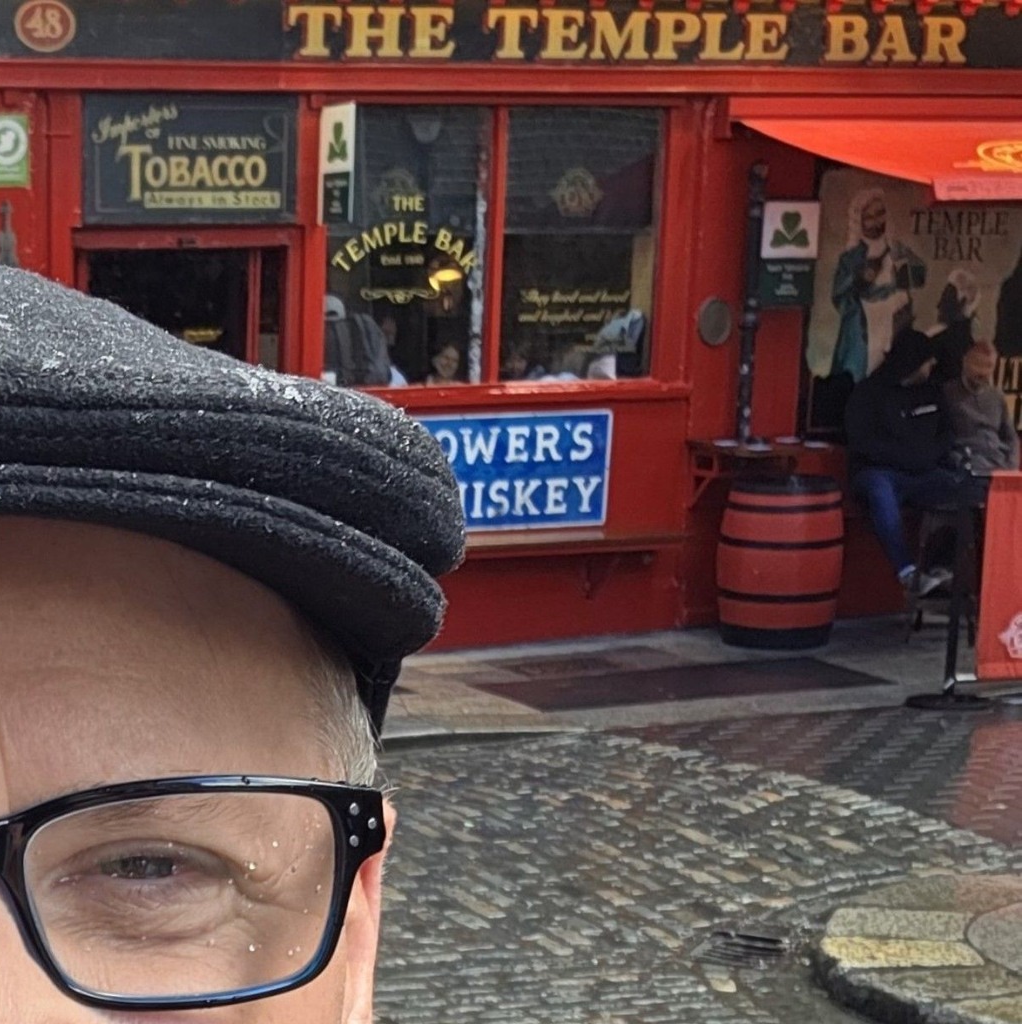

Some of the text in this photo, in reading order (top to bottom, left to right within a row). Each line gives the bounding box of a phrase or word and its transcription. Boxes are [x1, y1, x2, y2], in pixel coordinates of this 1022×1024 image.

[25, 7, 63, 39] 48
[288, 5, 967, 63] THE TEMPLE BAR
[167, 135, 268, 151] FINE SMOKING
[115, 144, 268, 202] TOBACCO
[392, 194, 426, 213] THE
[910, 210, 1010, 237] TEMPLE
[331, 220, 479, 276] TEMPLE BAR
[932, 236, 984, 263] BAR
[434, 422, 595, 466] OWER'S
[459, 475, 603, 520] ISKEY
